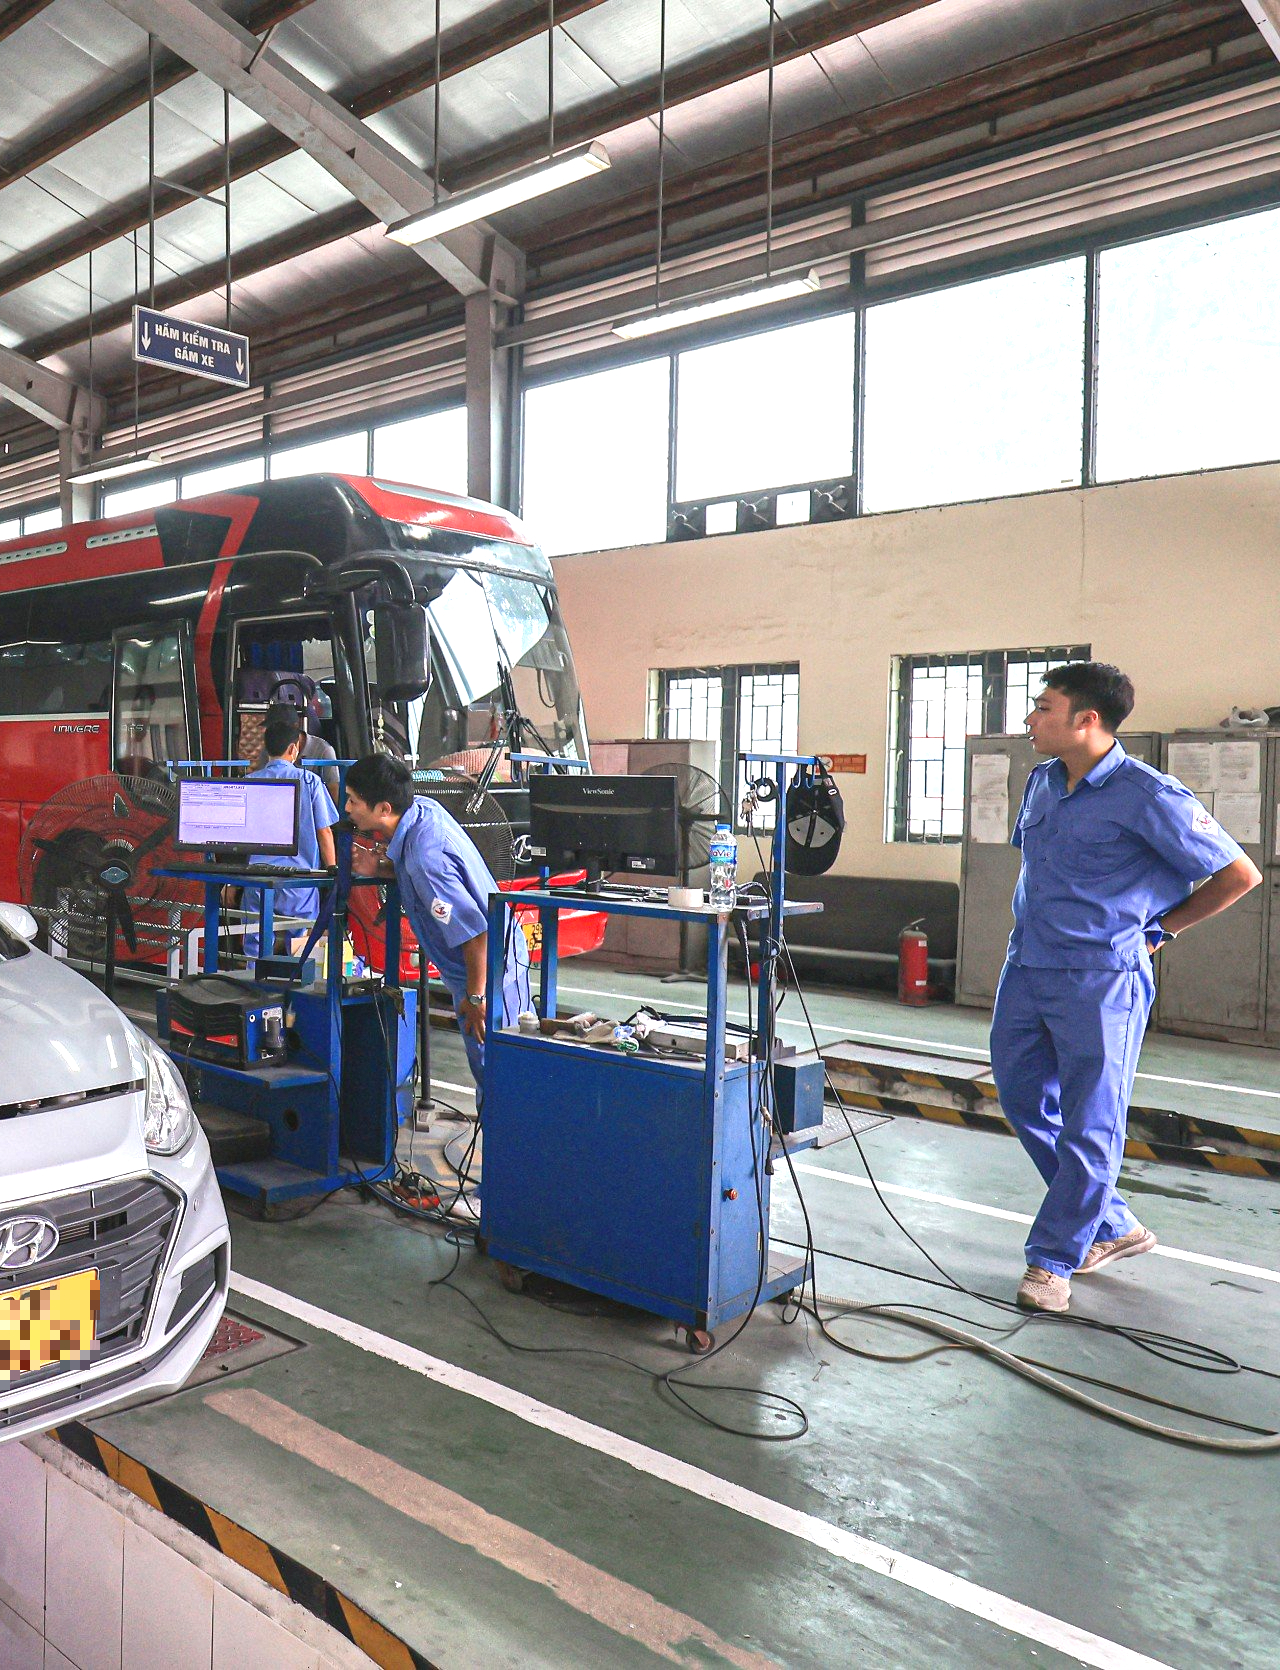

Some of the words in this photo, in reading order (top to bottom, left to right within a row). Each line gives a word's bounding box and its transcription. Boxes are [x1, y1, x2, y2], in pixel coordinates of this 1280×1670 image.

[182, 330, 209, 349] KIỂM
[211, 339, 231, 355] TRA
[201, 354, 215, 367] XE
[710, 849, 732, 857] aVie
